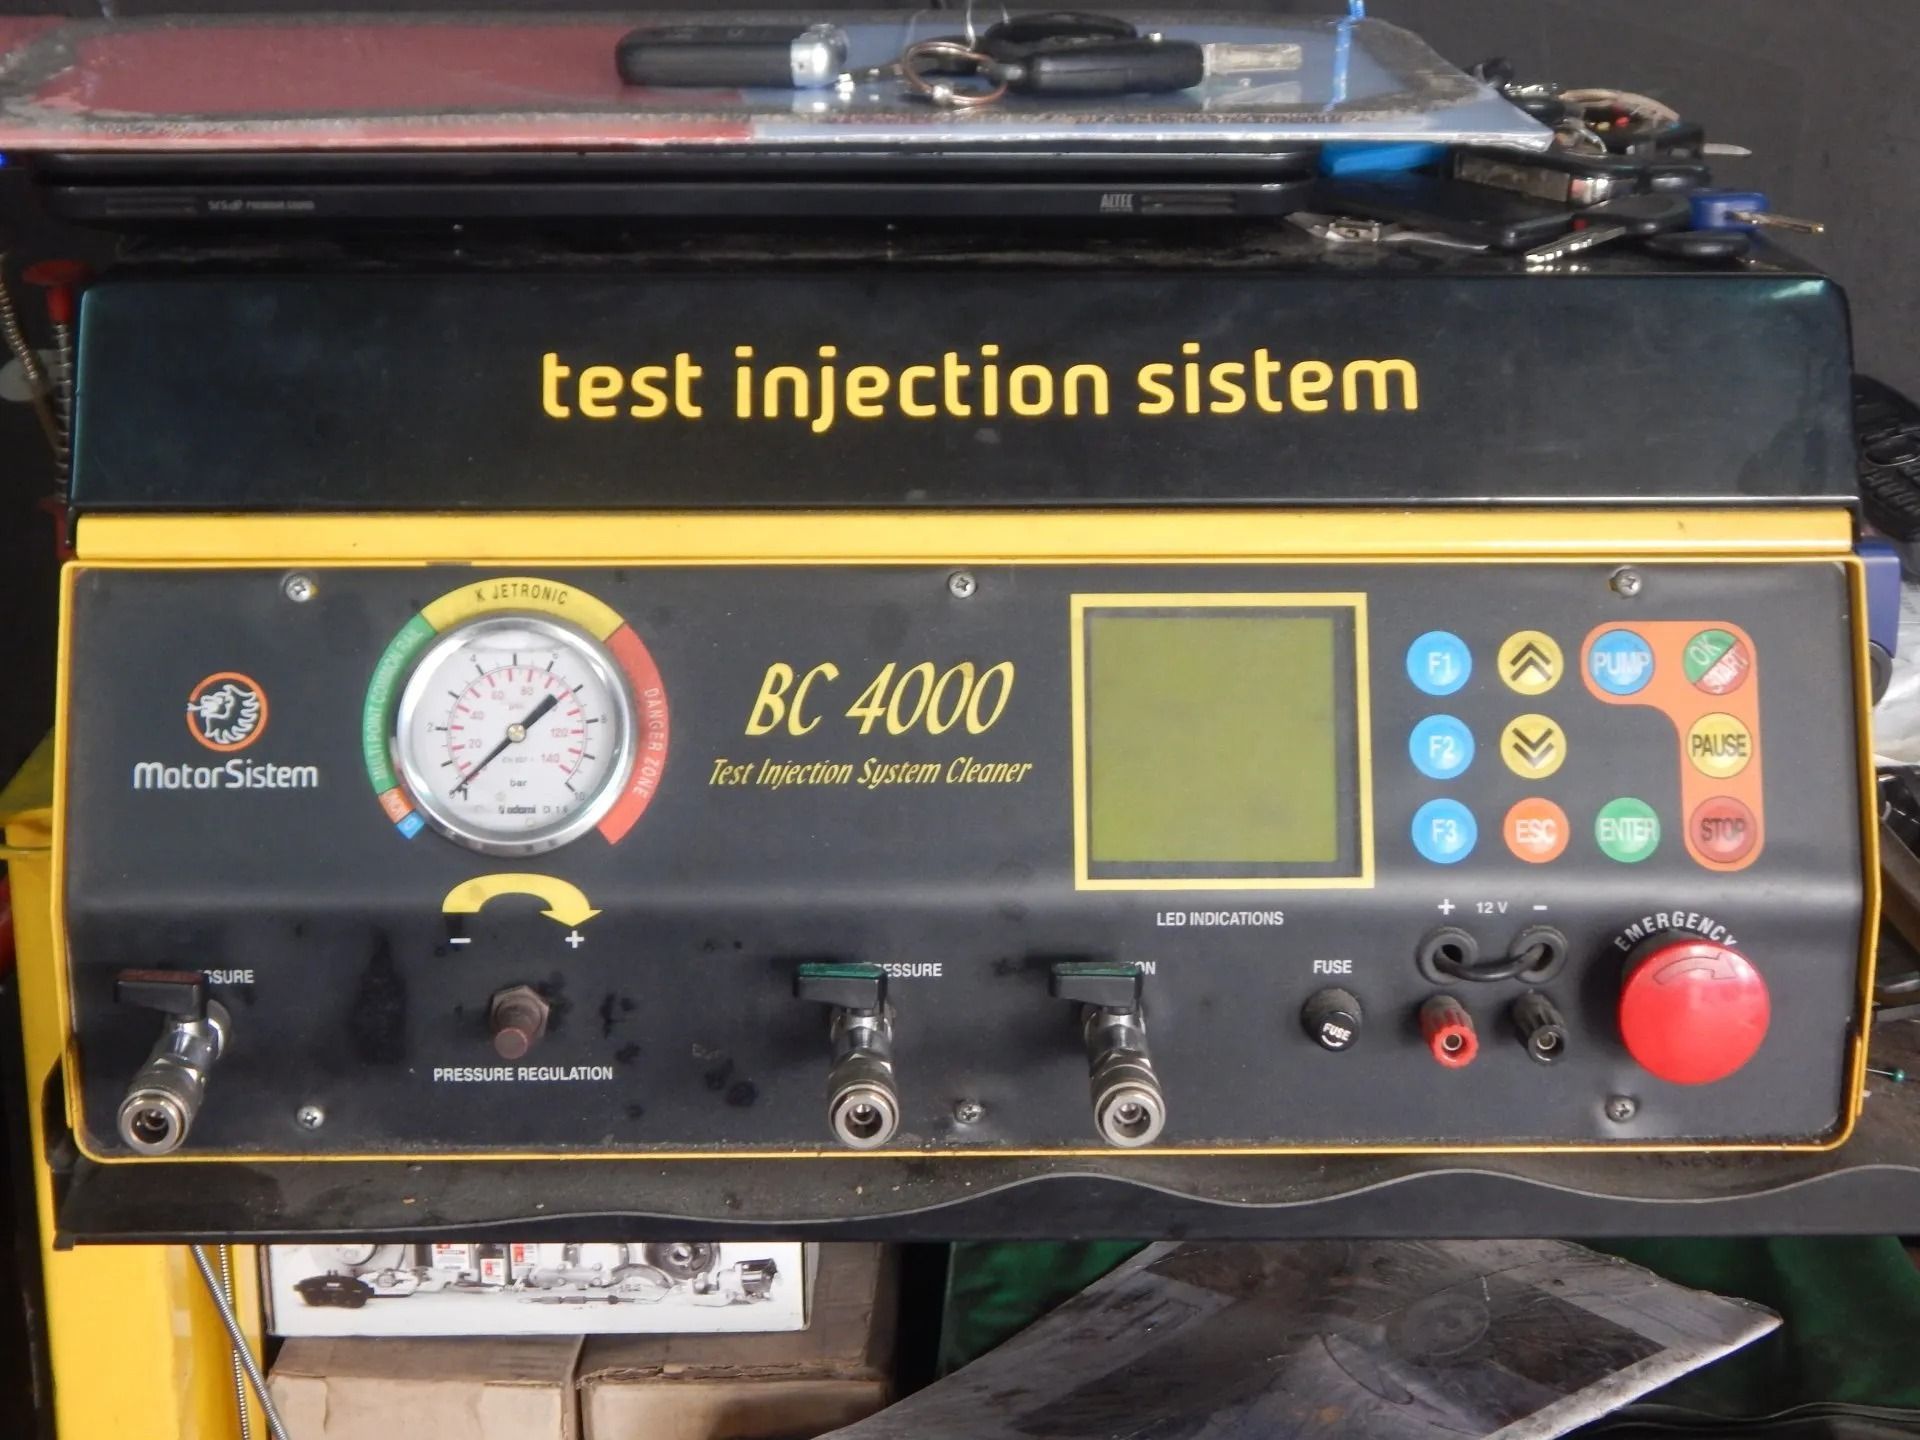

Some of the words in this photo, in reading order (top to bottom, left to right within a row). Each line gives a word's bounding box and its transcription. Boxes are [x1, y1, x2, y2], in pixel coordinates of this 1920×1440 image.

[543, 352, 702, 418] test
[735, 344, 1109, 433] injection
[1137, 342, 1418, 414] sistem
[474, 590, 486, 604] K
[492, 583, 569, 606] JETRONIC
[1690, 634, 1721, 665] OK
[1428, 652, 1451, 675] F1
[1593, 651, 1650, 676] PUMP
[745, 662, 840, 736] BC
[845, 661, 1015, 735] 4000
[645, 687, 666, 752] DANGER
[1429, 735, 1455, 758] F2
[1692, 734, 1747, 757] PAUSE
[133, 758, 319, 789] MotorSistem
[509, 779, 527, 787] bar
[633, 759, 661, 797] ZONE
[709, 758, 754, 785] Test
[756, 758, 853, 790] Injection
[857, 757, 941, 789] System
[946, 756, 1033, 784] Cleaner
[1431, 819, 1457, 843] F3
[1515, 818, 1557, 844] ESC
[1600, 817, 1659, 842] ENTER
[1701, 818, 1746, 842] STOP
[1156, 912, 1186, 926] LED
[1190, 911, 1284, 926] INDICATIONS
[1476, 901, 1494, 914] 12
[1497, 901, 1508, 914] V
[1614, 911, 1739, 952] EMERGENCY
[873, 962, 942, 977] ESSURE
[1313, 960, 1352, 974] FUSE
[1323, 1022, 1351, 1041] FUSE
[433, 1067, 514, 1082] PRESSURE
[518, 1066, 613, 1081] REGULATION
